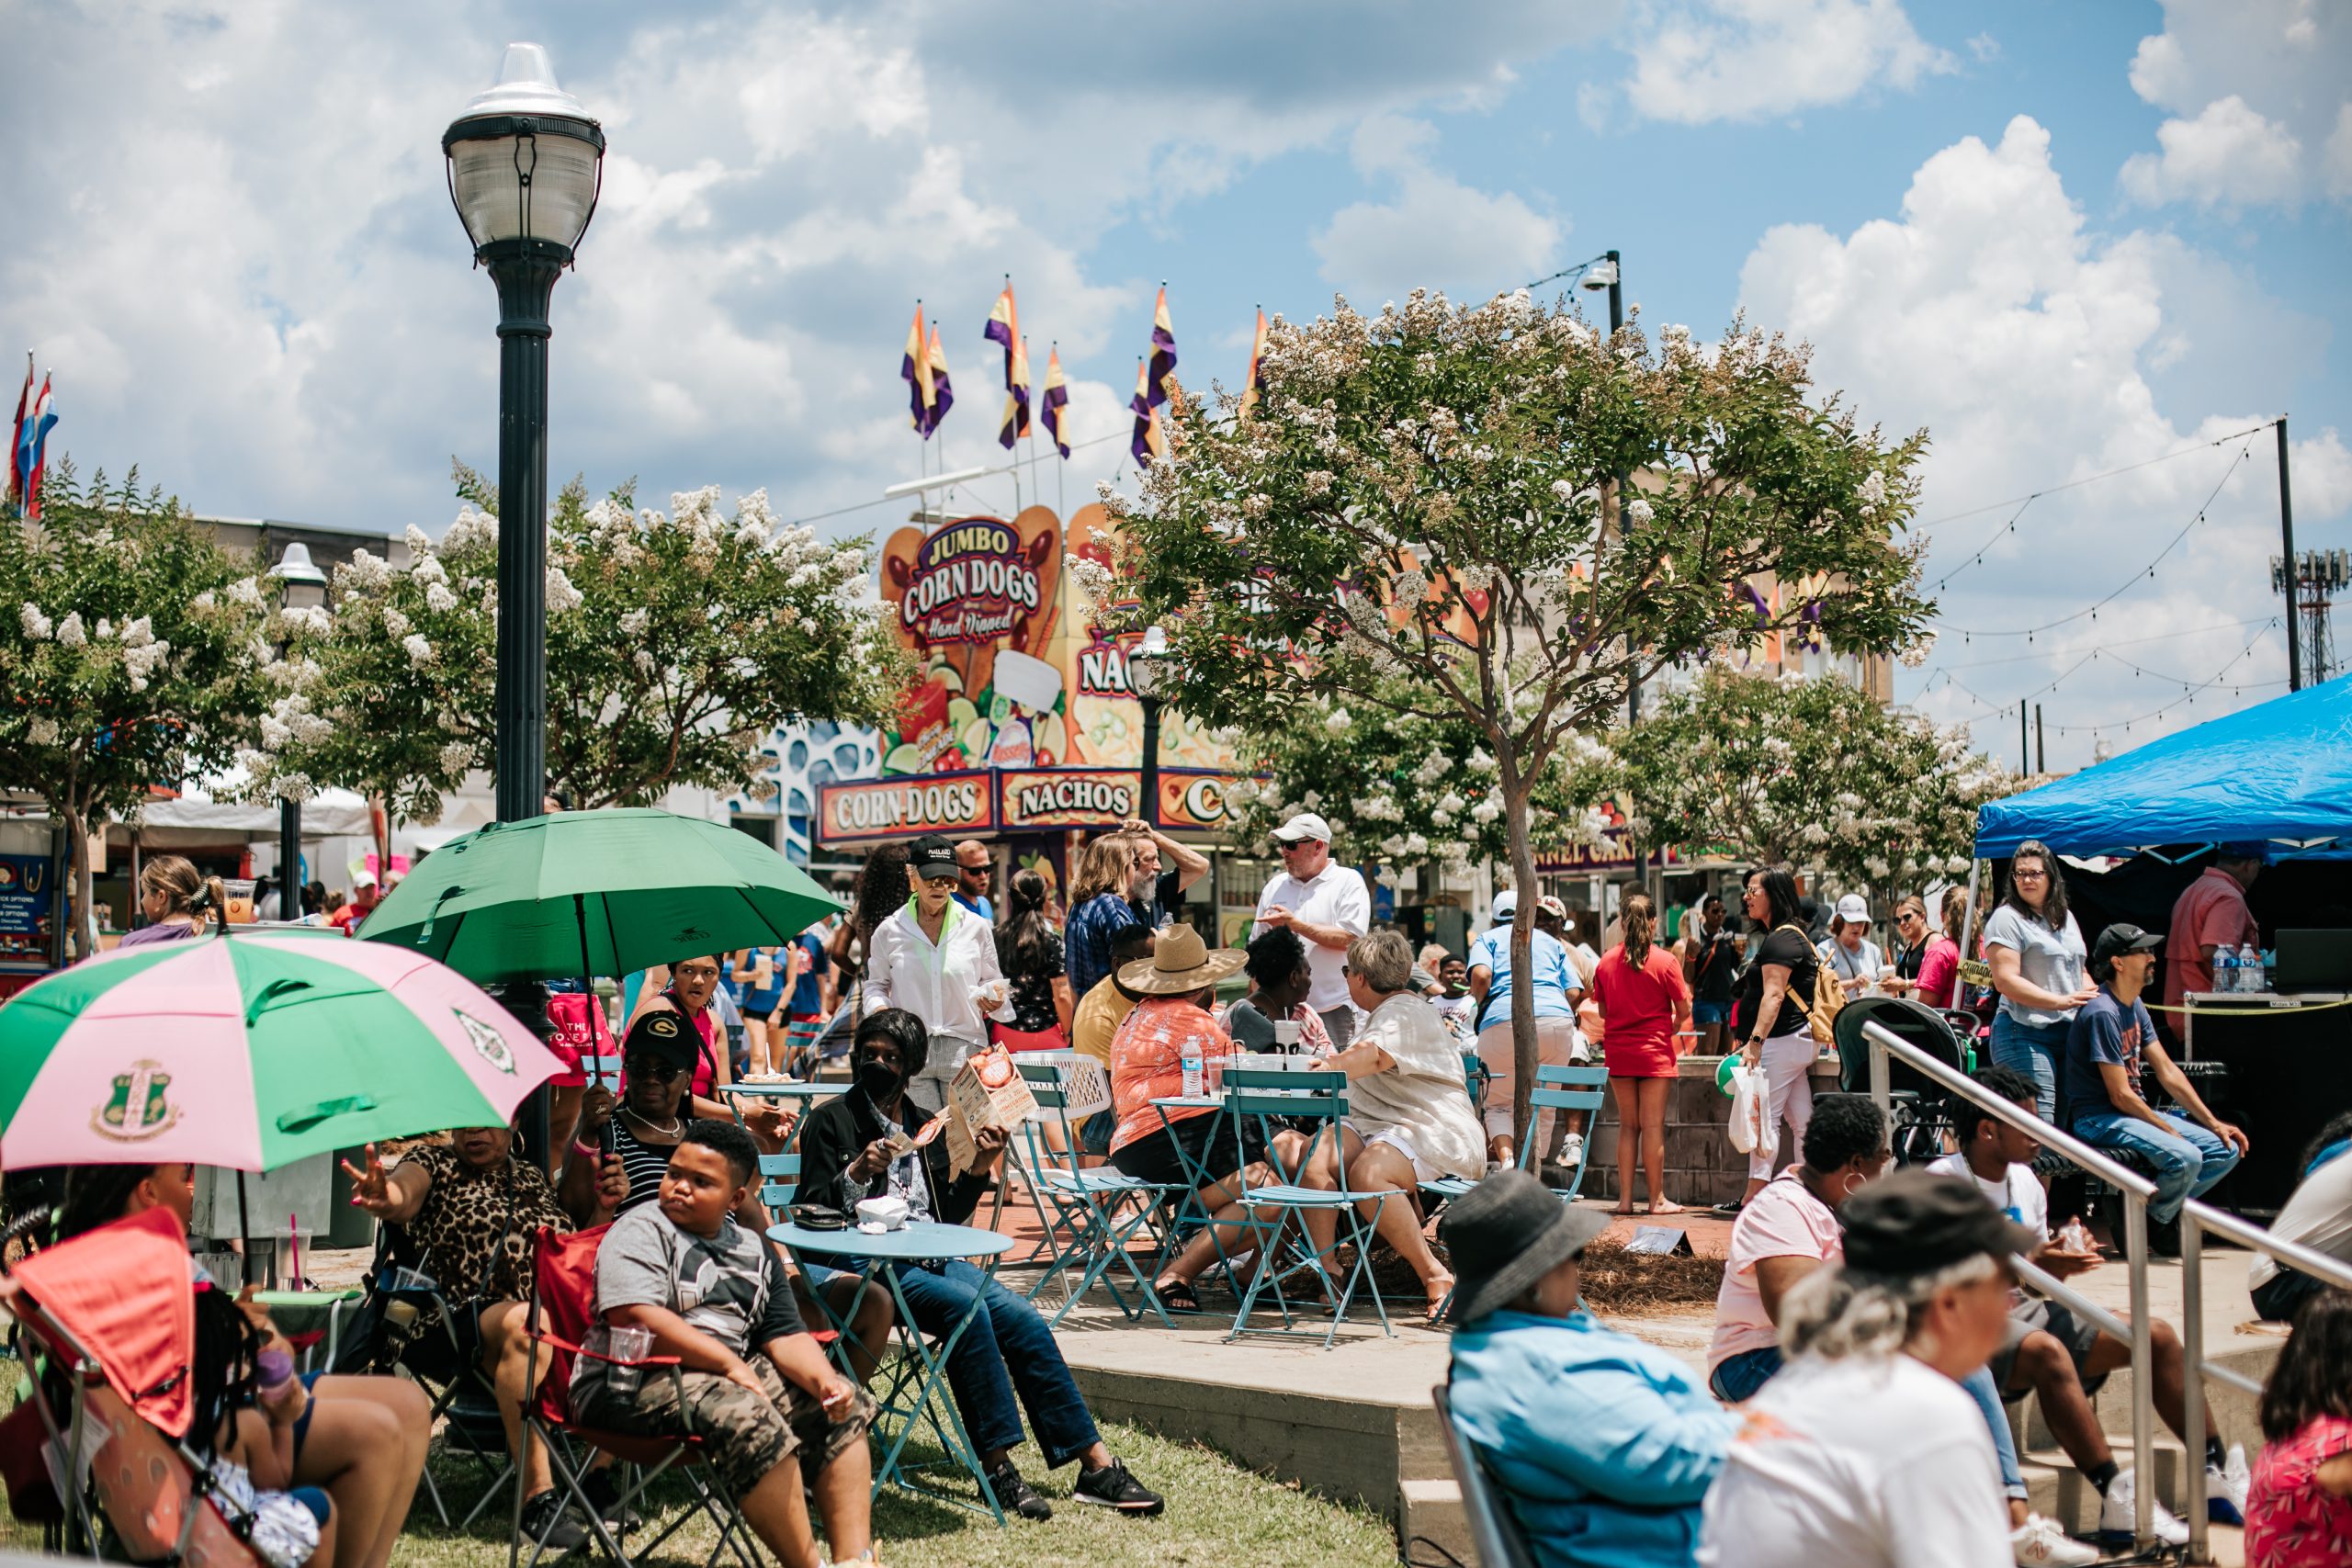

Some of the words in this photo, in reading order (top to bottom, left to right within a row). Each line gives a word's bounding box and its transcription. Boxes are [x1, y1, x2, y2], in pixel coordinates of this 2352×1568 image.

[929, 526, 1010, 566] JUMBO
[904, 561, 966, 624] CORN
[969, 558, 1039, 608] DOGS
[928, 611, 964, 638] Hand
[965, 604, 1014, 637] Dipped
[837, 789, 900, 829] CORN
[907, 782, 976, 822] DOGS
[1022, 781, 1130, 817] NACHOS
[567, 1022, 586, 1031] THE
